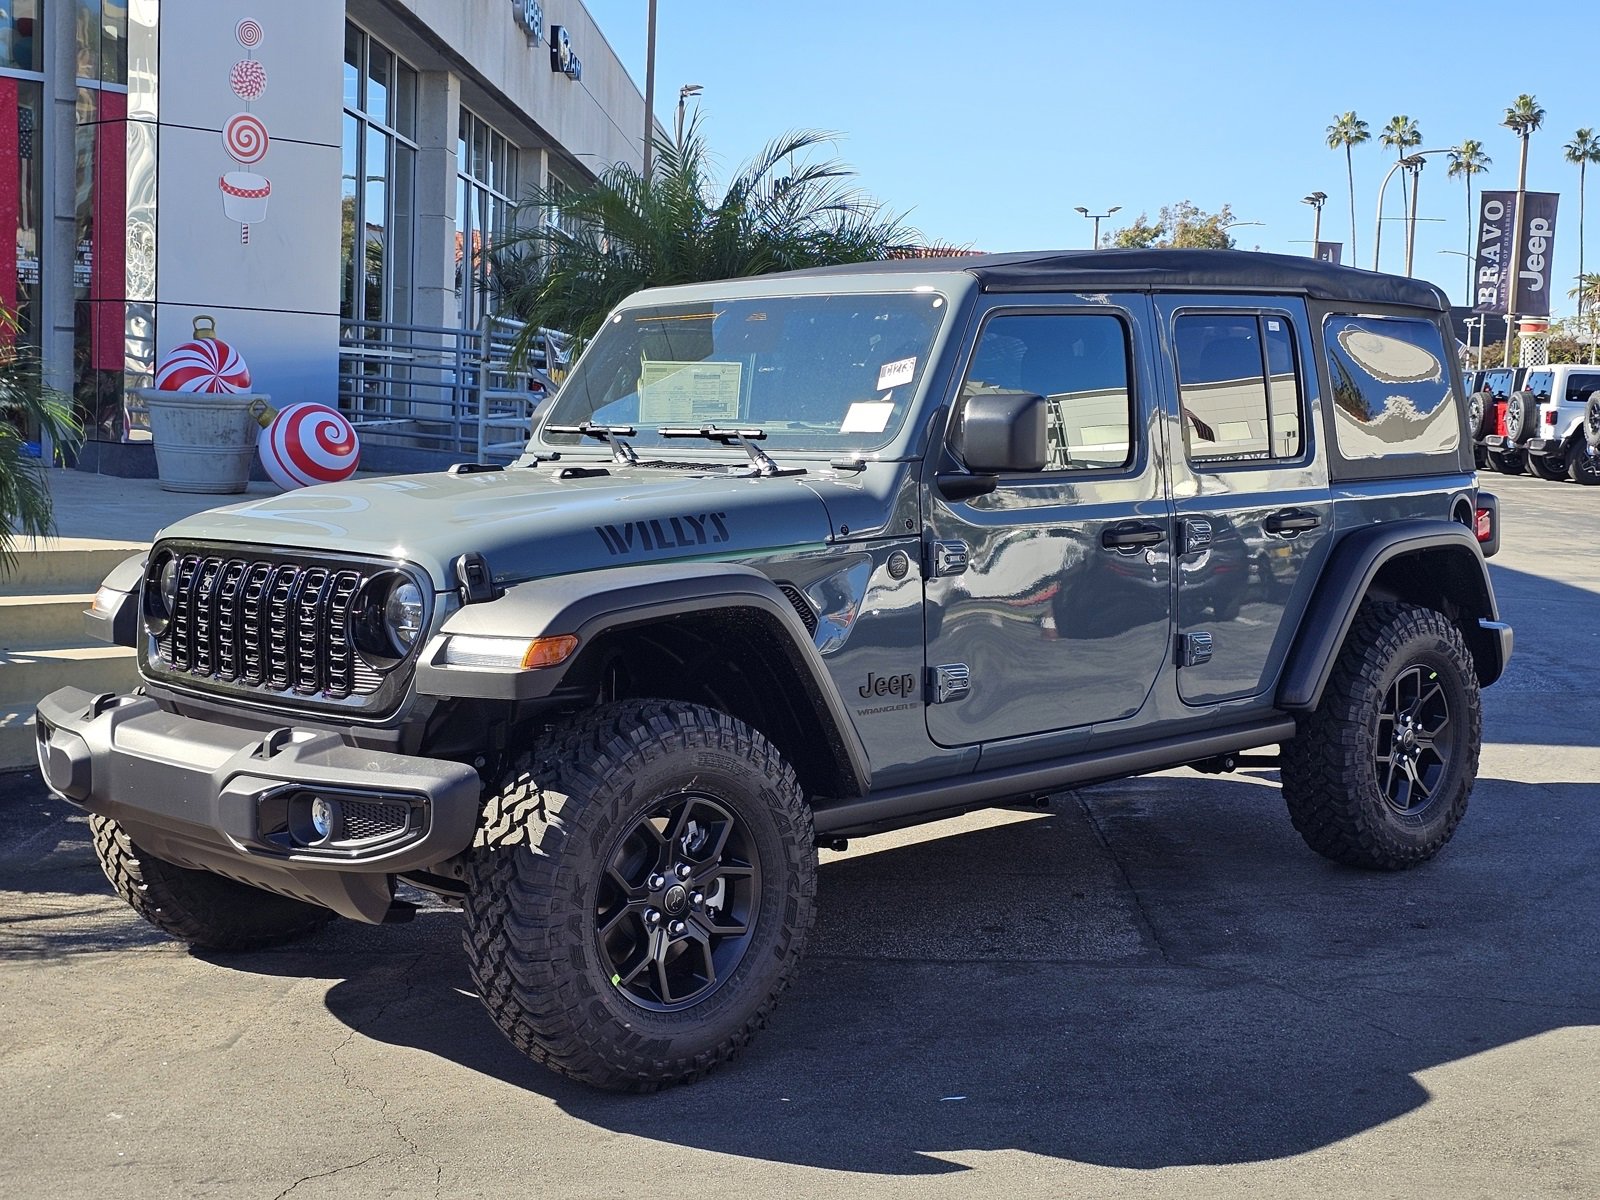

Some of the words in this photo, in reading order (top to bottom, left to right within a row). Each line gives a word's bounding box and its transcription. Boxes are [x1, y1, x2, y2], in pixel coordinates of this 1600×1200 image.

[1503, 200, 1512, 247] DEALERSHIP
[1478, 200, 1504, 305] BRAVO
[1519, 217, 1552, 292] Jeep
[594, 511, 730, 556] WILLYS
[858, 672, 916, 698] Jeep
[857, 703, 908, 716] WRANGLER
